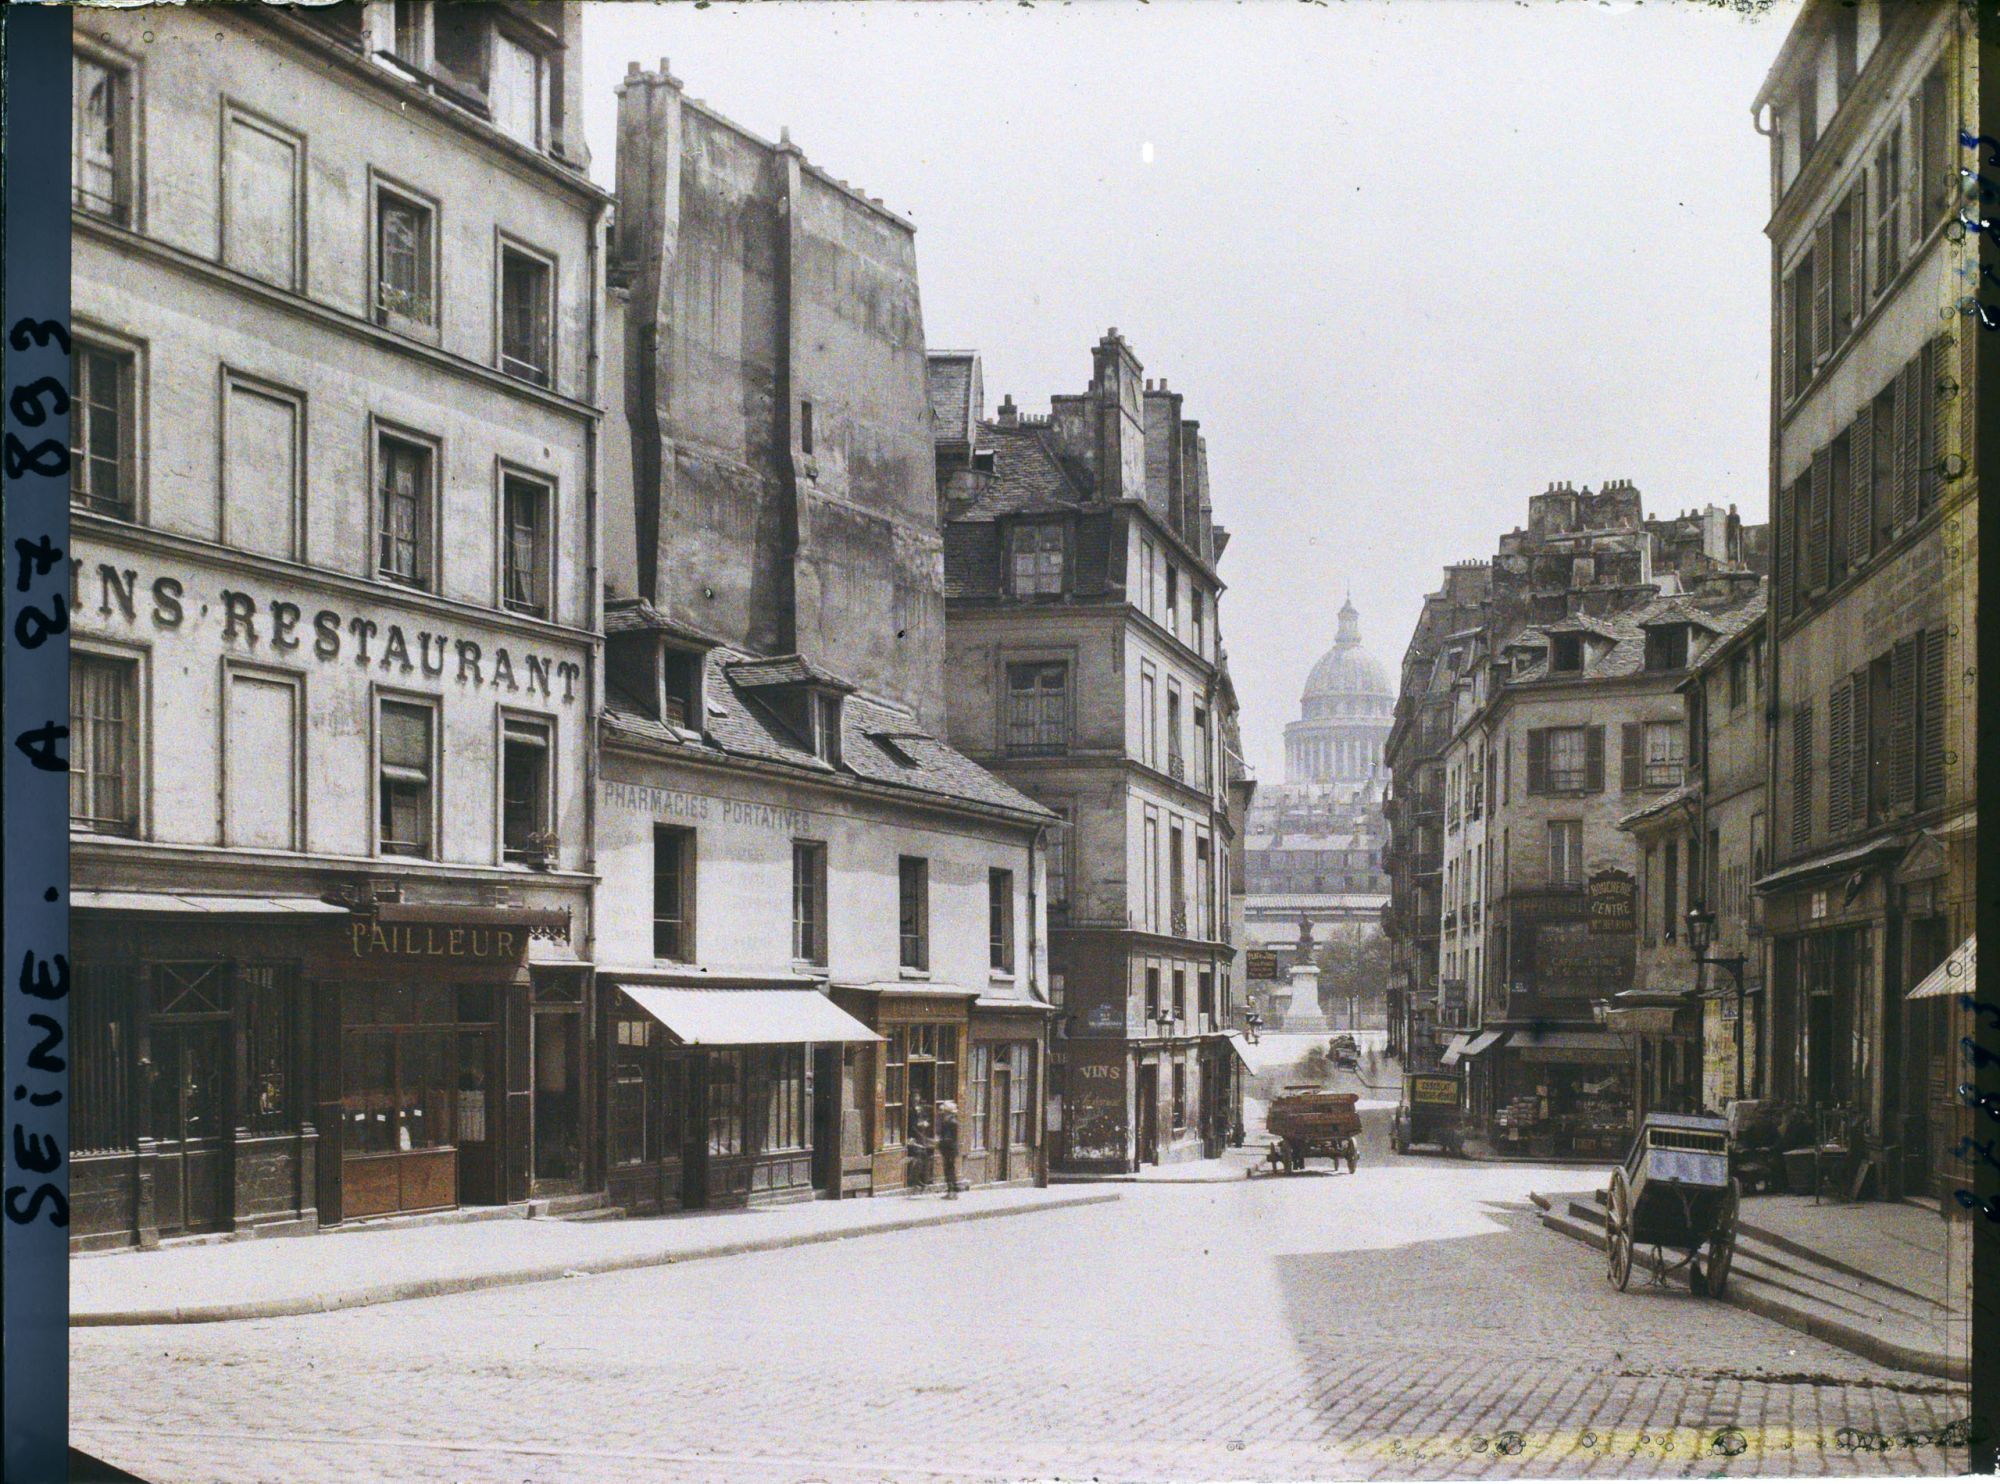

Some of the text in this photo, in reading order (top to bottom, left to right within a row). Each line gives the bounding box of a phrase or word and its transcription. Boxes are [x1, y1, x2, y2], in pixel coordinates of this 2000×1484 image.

[6, 318, 69, 479] 893
[15, 535, 69, 649] 27
[220, 588, 581, 704] RESTAURANT
[15, 721, 69, 772] A
[604, 781, 810, 833] PHARMACIES PORTATIVES
[1591, 901, 1632, 916] CENTRE
[352, 922, 514, 957] TAILLEUR
[1080, 1065, 1121, 1079] VINS
